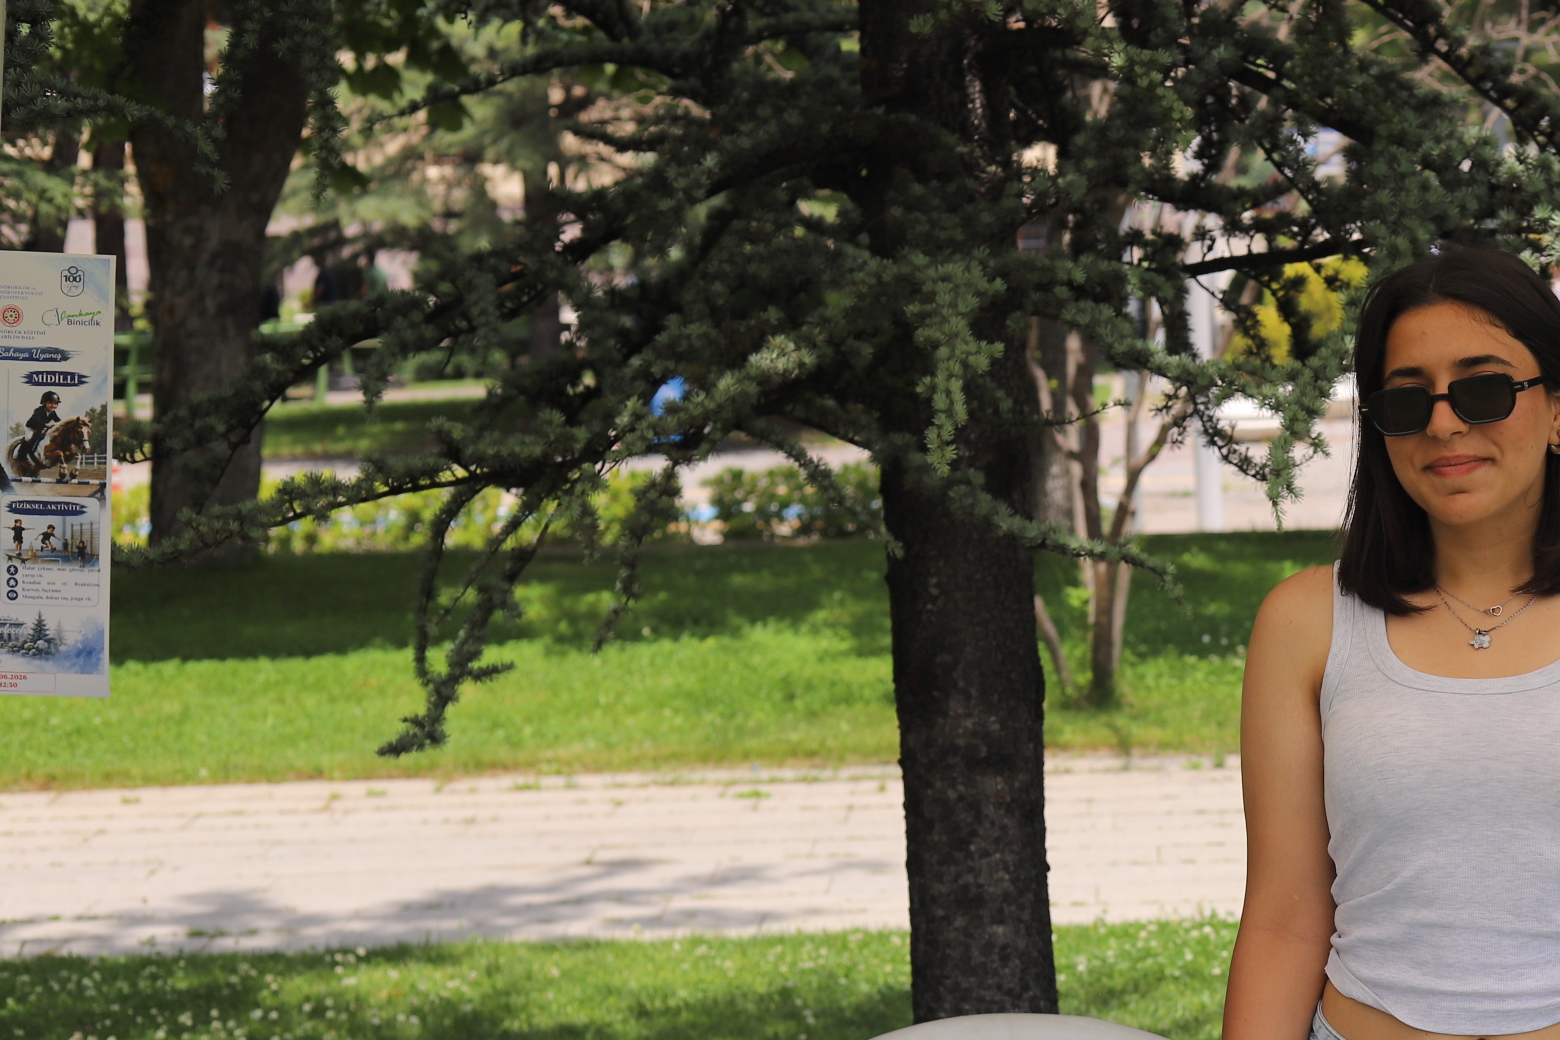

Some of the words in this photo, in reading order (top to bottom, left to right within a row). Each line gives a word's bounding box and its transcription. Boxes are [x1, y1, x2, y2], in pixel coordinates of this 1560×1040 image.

[66, 318, 100, 326] Binicilik
[32, 348, 62, 360] Uyanış
[32, 373, 78, 384] MİDİLLİ
[12, 501, 44, 510] FİZİKSEL
